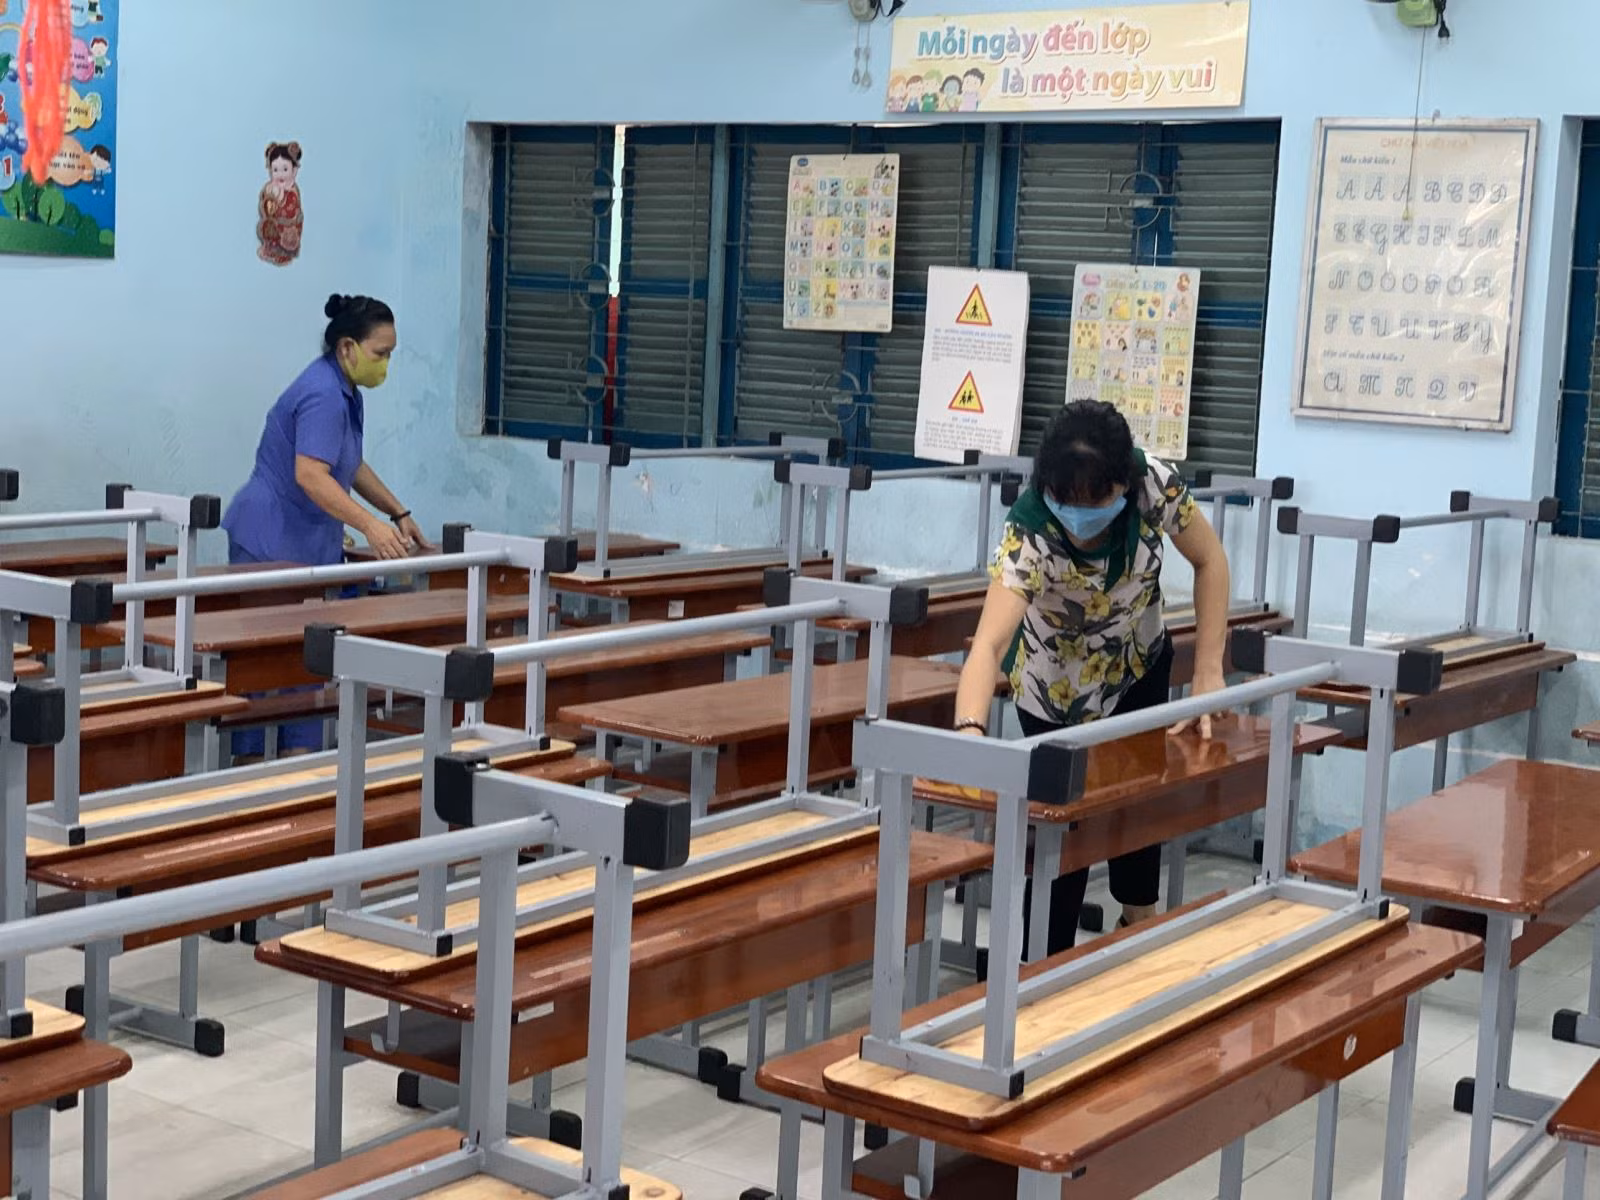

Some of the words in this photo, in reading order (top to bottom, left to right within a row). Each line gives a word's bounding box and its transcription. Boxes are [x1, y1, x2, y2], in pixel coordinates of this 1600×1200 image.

[918, 26, 966, 57] Mỗi
[972, 27, 1037, 62] ngày
[1043, 20, 1095, 53] đến
[1102, 22, 1148, 57] lớp
[1001, 68, 1025, 94] là
[1031, 65, 1086, 101] một
[1090, 64, 1163, 99] ngày
[1168, 61, 1214, 90] vui
[1424, 181, 1442, 203] B
[1370, 315, 1390, 337] U
